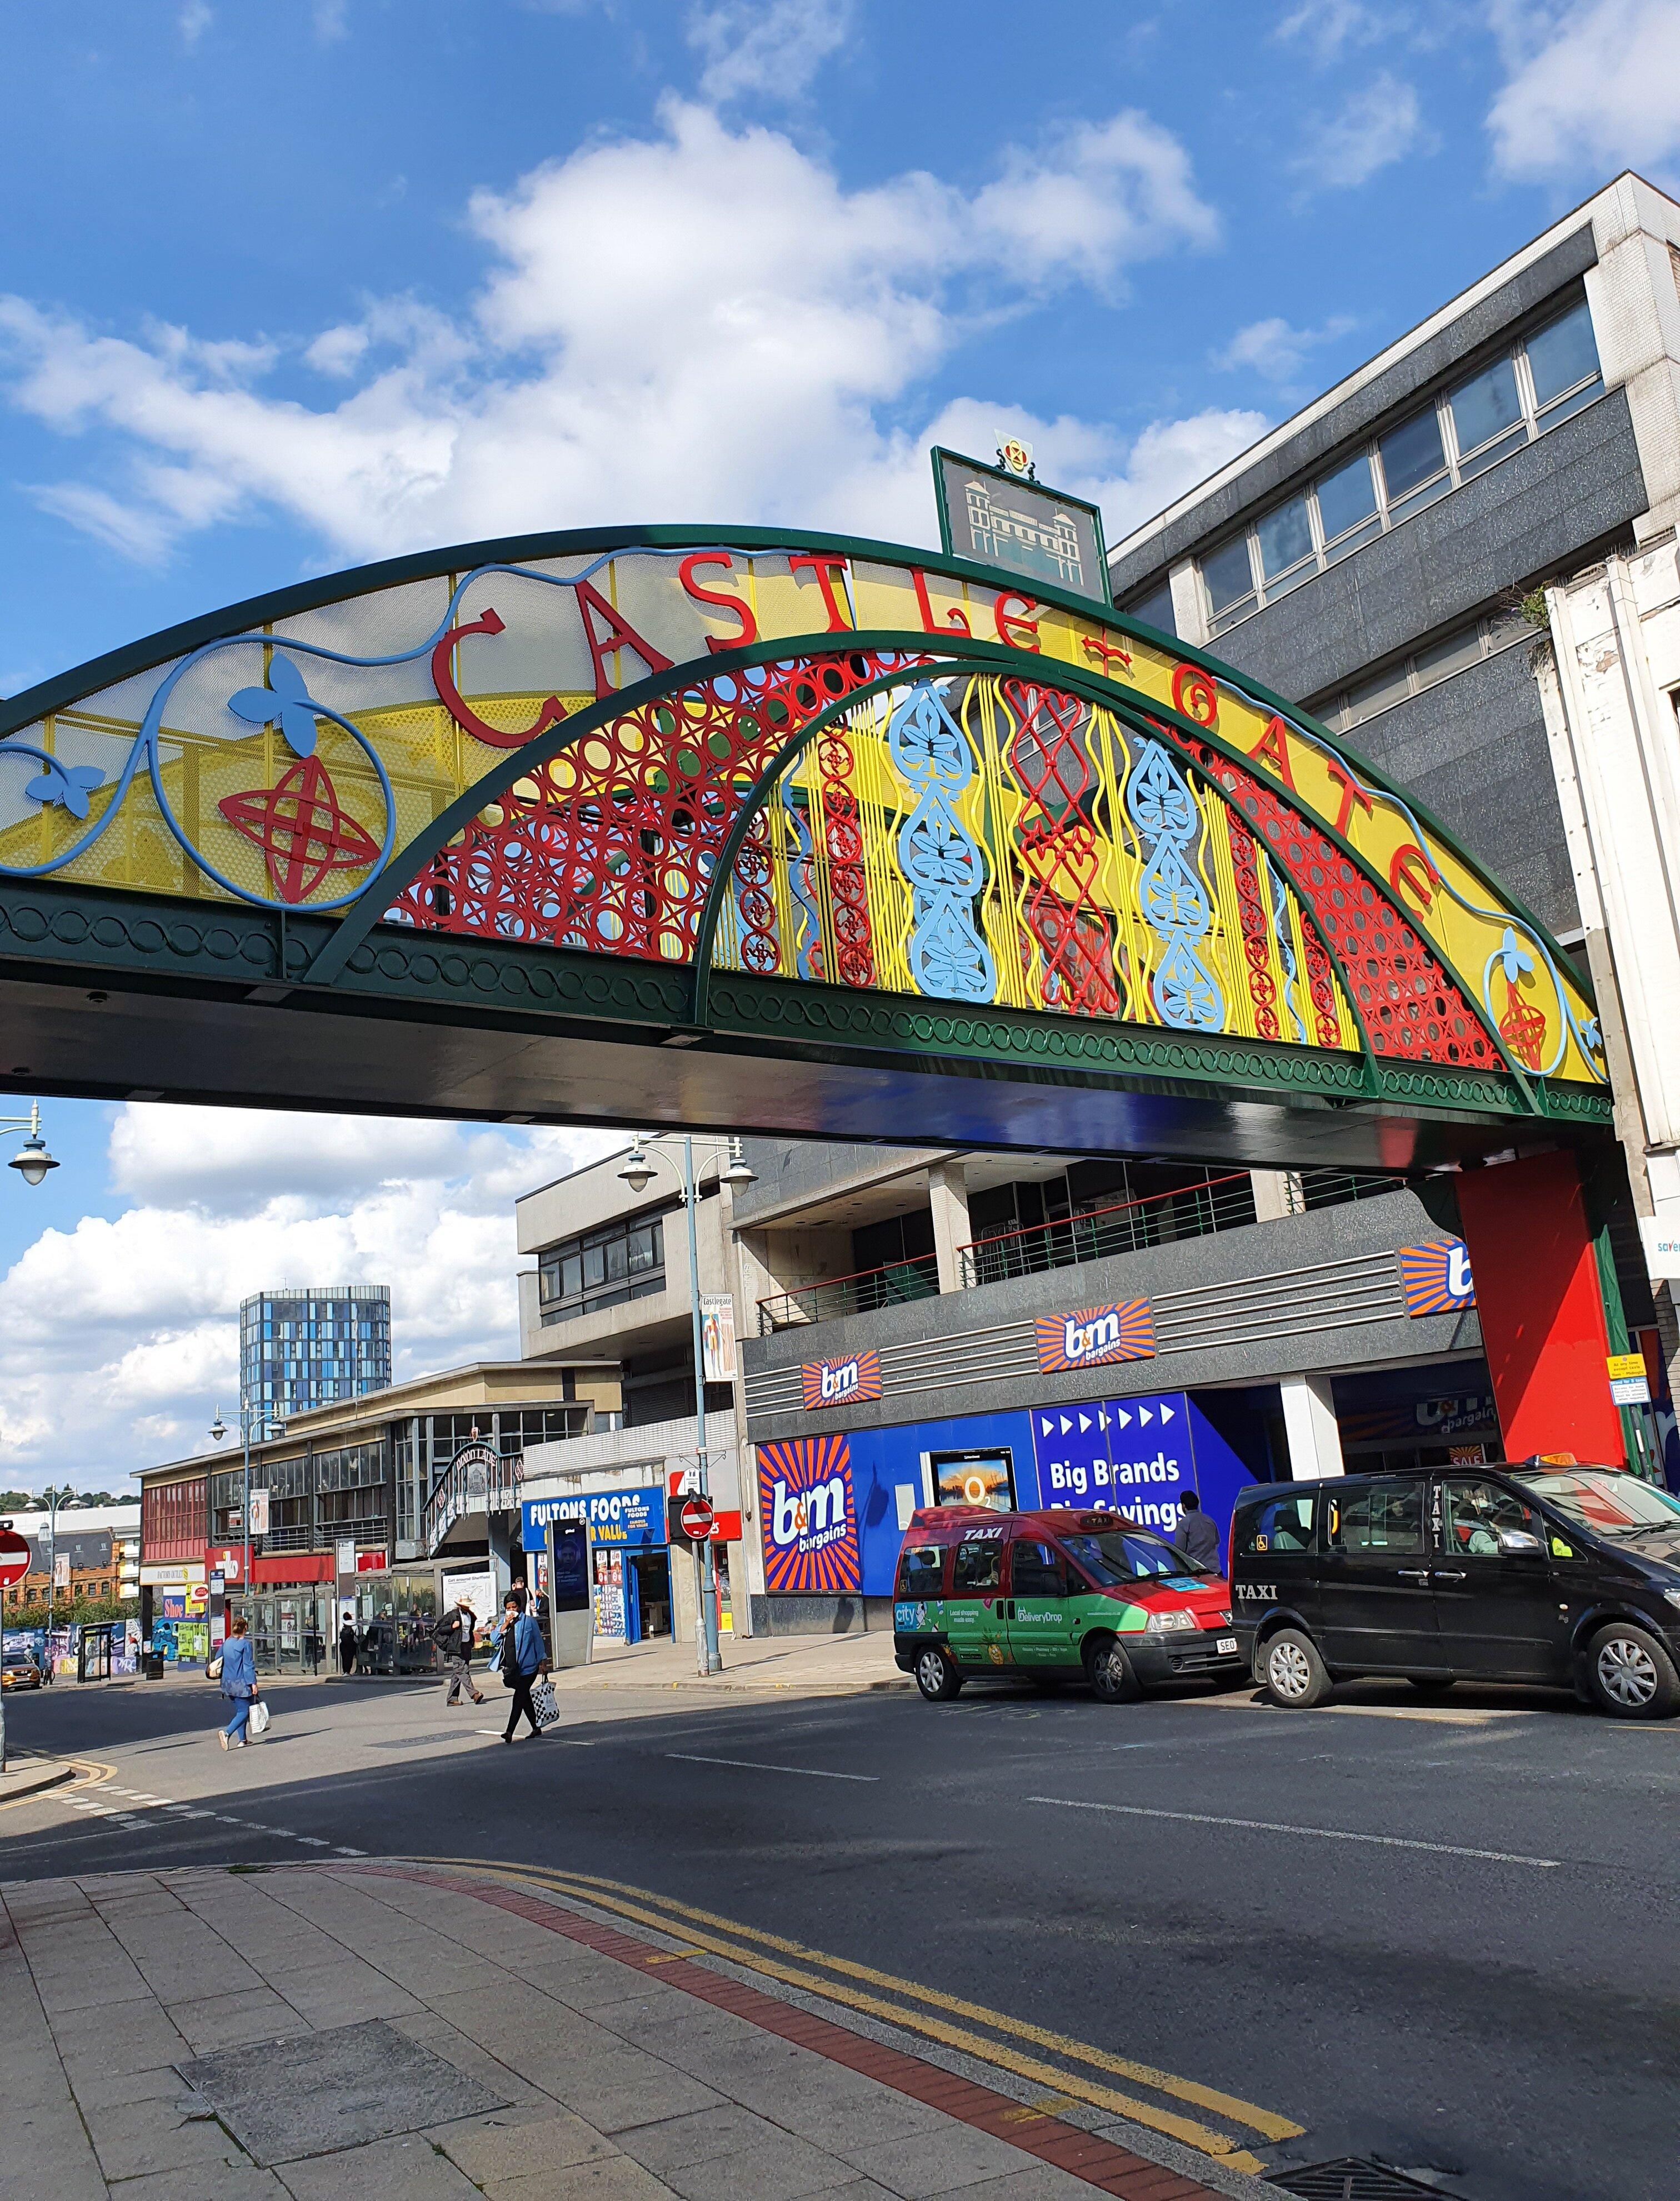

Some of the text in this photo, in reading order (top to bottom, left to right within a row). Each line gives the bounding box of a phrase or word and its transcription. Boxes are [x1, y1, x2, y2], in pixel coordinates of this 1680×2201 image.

[703, 1297, 732, 1306] Castlegate
[1064, 1313, 1121, 1359] b&m
[1086, 1339, 1121, 1361] bargains
[822, 1362, 858, 1398] b&m
[835, 1383, 859, 1400] bargains
[1447, 1407, 1495, 1429] bargain
[1453, 1455, 1481, 1466] SALE
[1050, 1452, 1179, 1494] Big Brands
[531, 1499, 587, 1527] FULTONS
[773, 1477, 847, 1545] b&m
[1432, 1485, 1441, 1548] TAXI
[799, 1523, 847, 1553] bargains
[964, 1527, 1003, 1540] TAXI
[1235, 1584, 1278, 1600] TAXI
[164, 1598, 183, 1618] Shoe
[896, 1604, 916, 1625] city
[1018, 1609, 1062, 1624] DeliveryDrop
